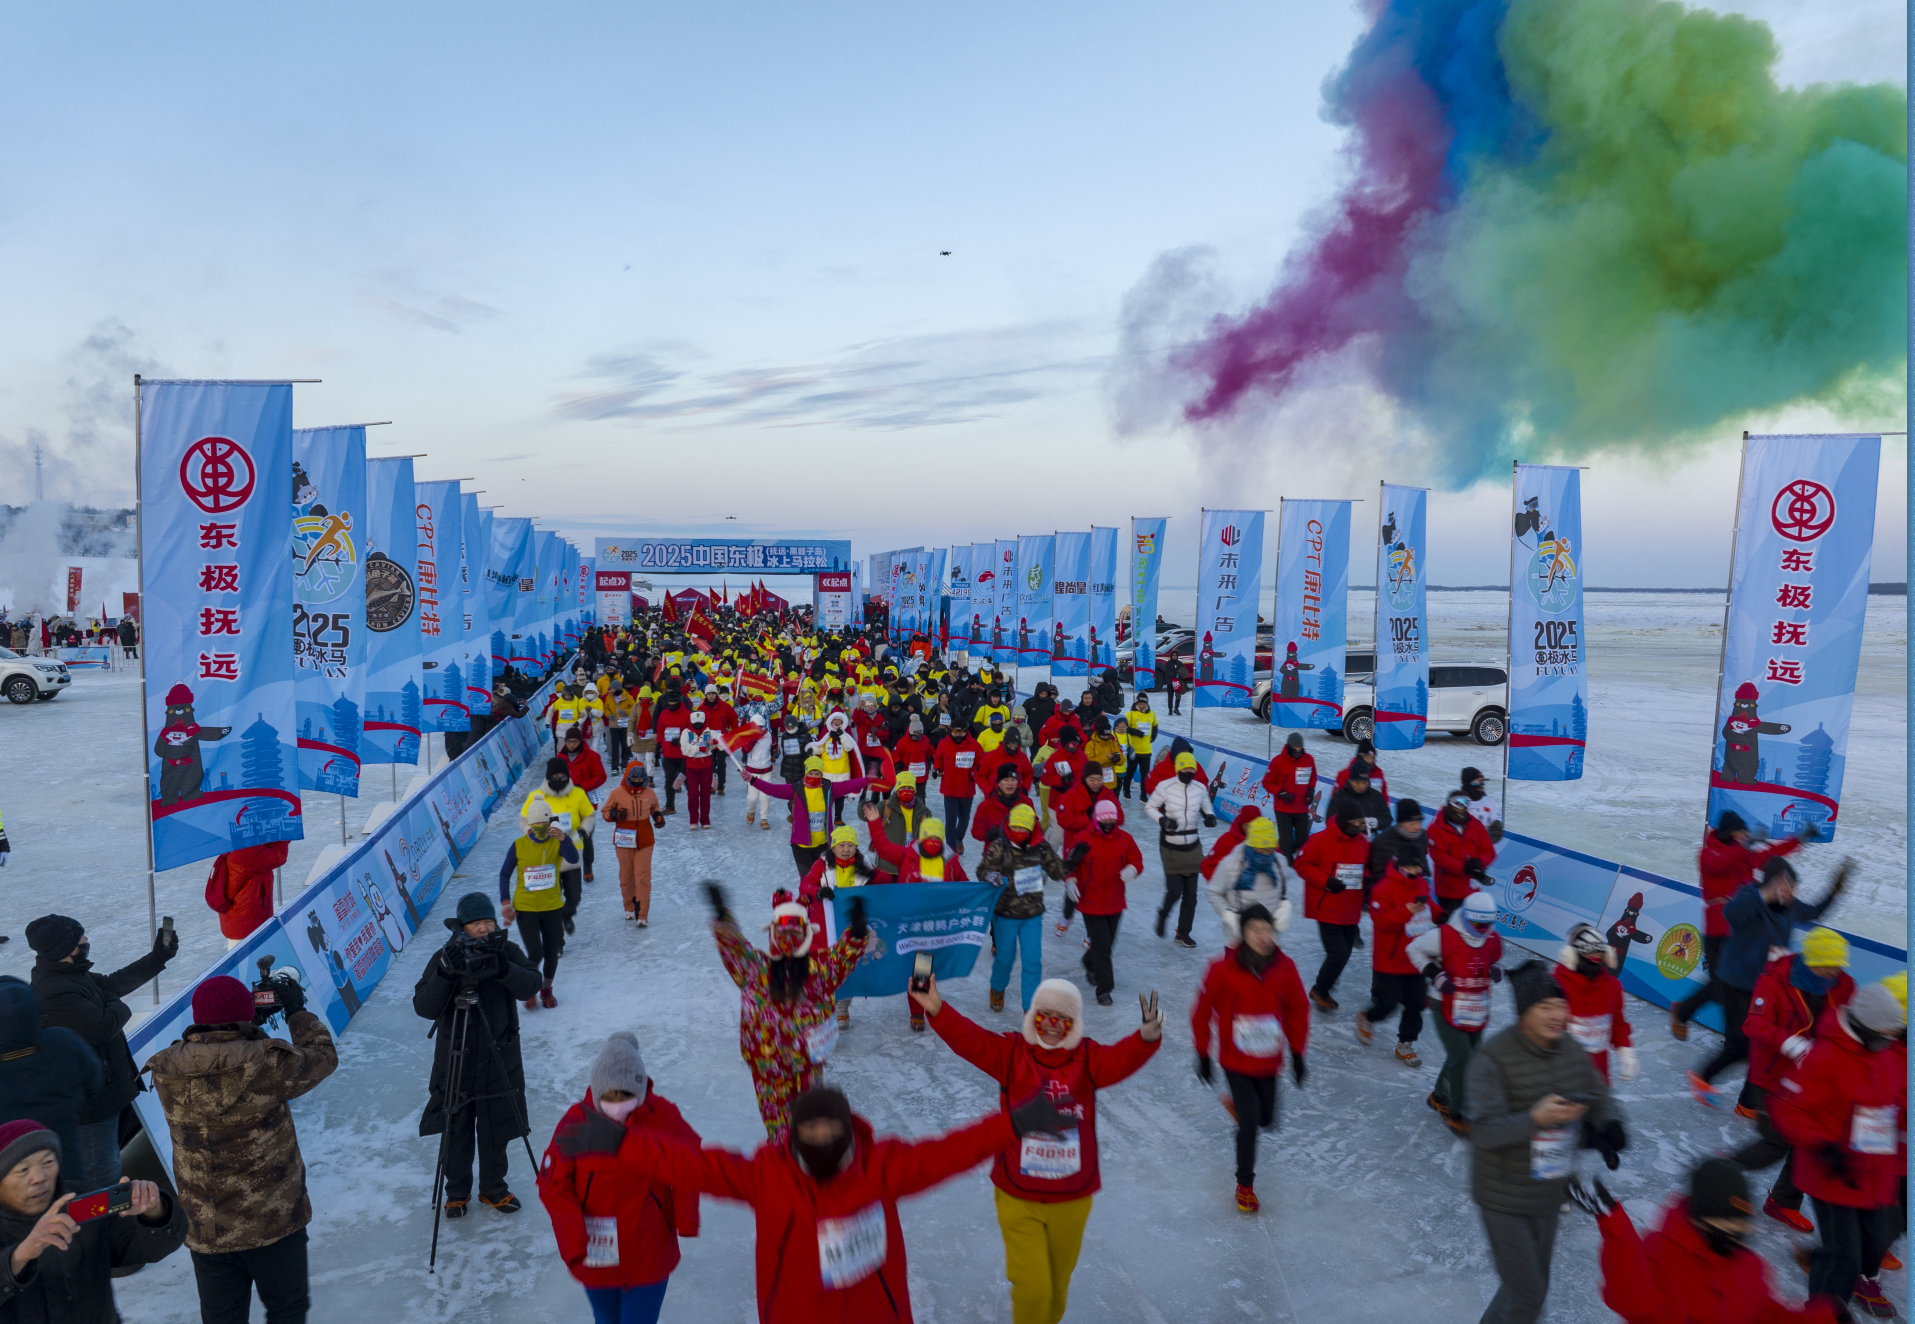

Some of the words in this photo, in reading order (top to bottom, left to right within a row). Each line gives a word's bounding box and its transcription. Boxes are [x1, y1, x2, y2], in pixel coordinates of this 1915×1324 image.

[641, 544, 765, 568] 2025中国东极
[767, 556, 828, 568] 冰上马拉松
[599, 576, 618, 586] 起点
[830, 577, 848, 587] 起点
[1001, 566, 1013, 616] 未来广告
[1214, 553, 1239, 633] 未来广告
[199, 522, 241, 682] 东极抚远
[1766, 548, 1815, 685] 东极抚远
[1535, 620, 1577, 650] 2025
